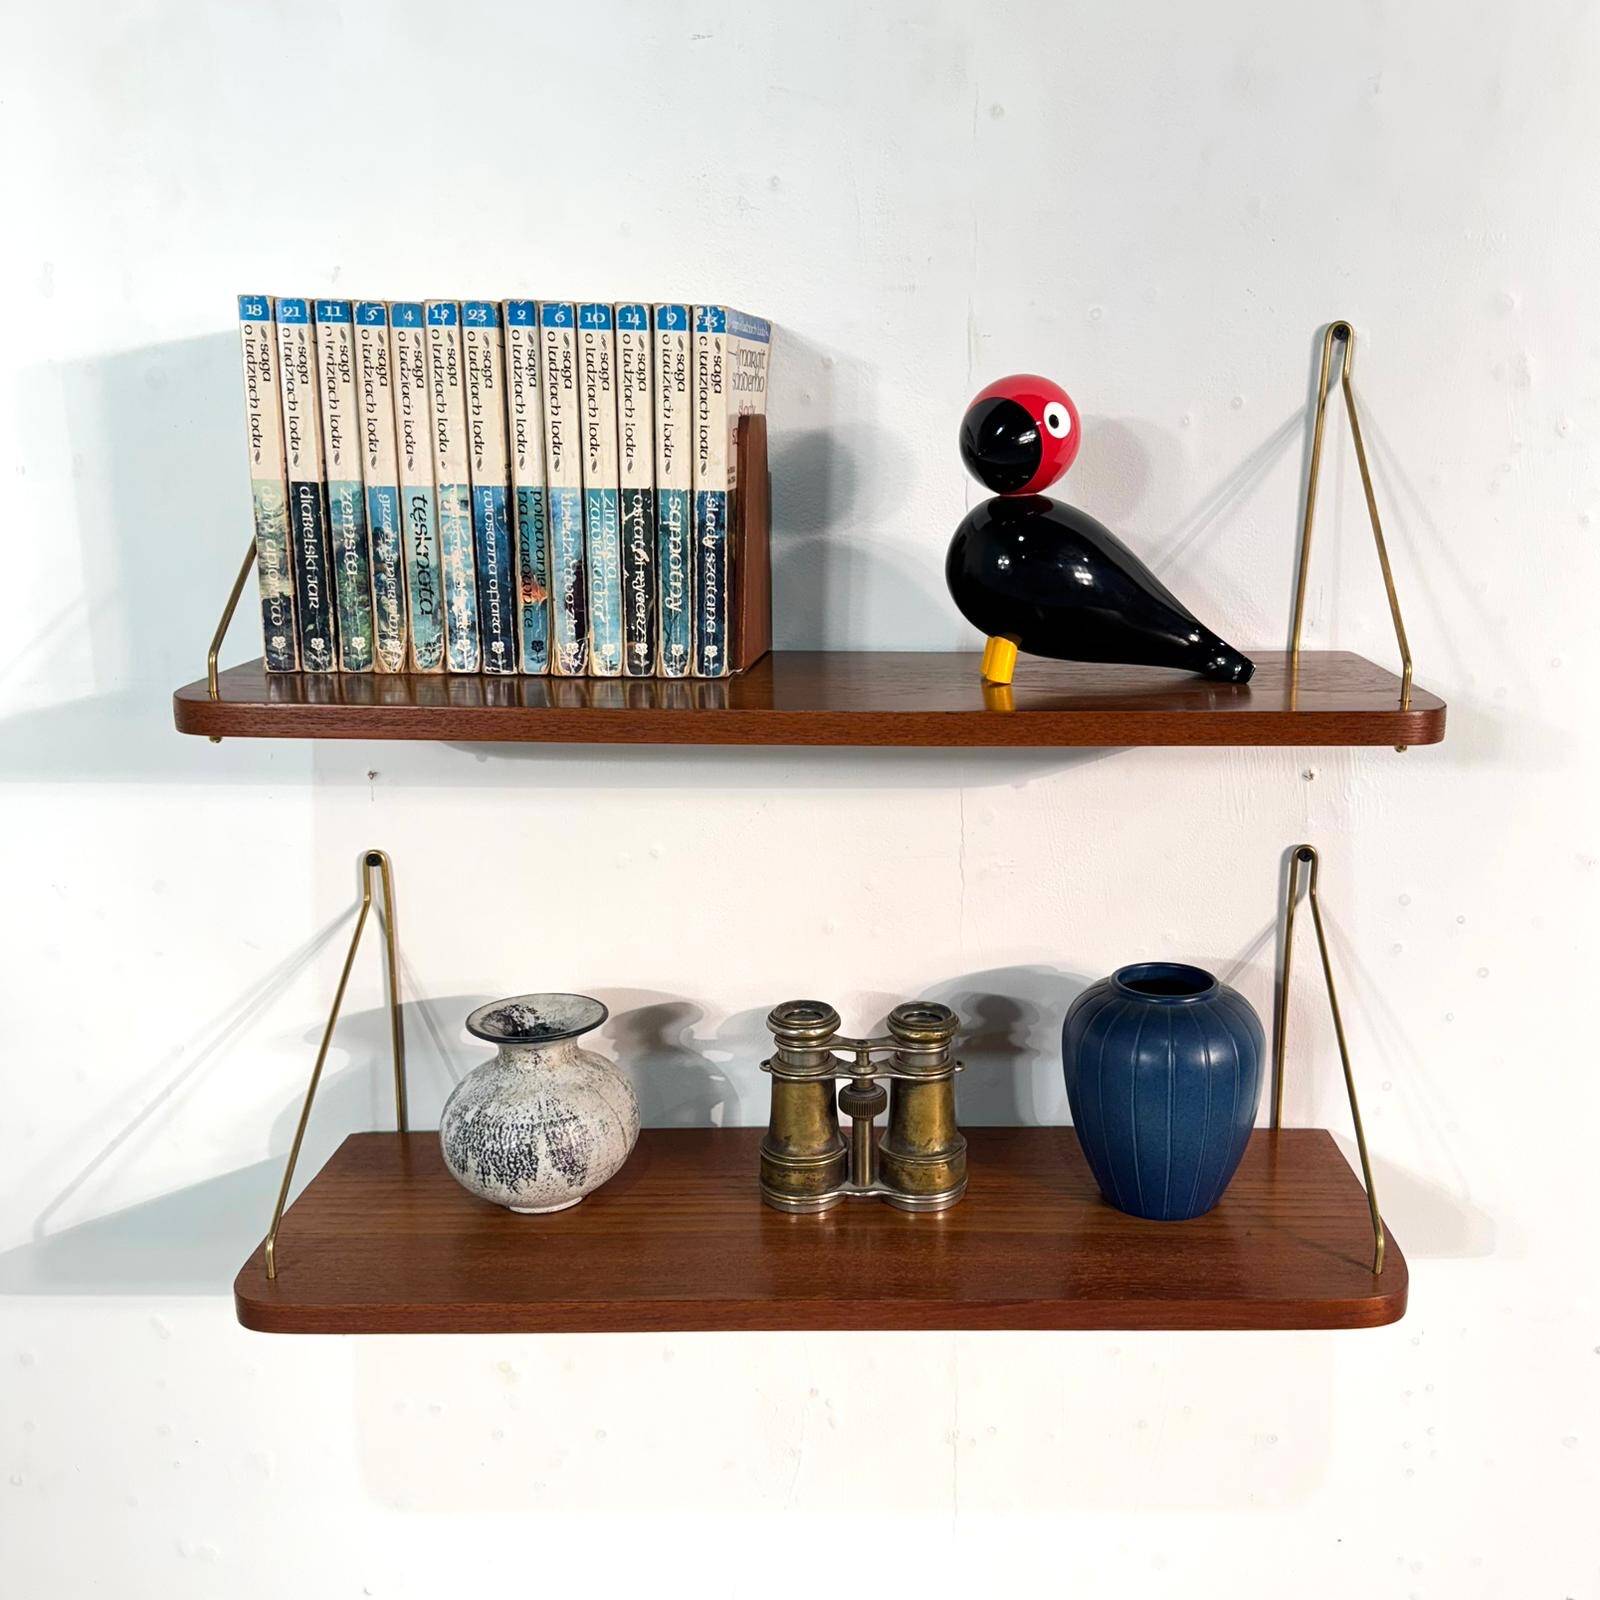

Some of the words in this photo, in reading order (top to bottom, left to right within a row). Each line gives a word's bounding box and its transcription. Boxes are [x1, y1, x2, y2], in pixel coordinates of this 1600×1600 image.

[246, 305, 262, 316] 18
[284, 308, 300, 317] 21
[325, 306, 342, 316] 11
[366, 311, 378, 320] 5
[404, 311, 413, 321] 4
[468, 310, 486, 321] 23
[517, 311, 526, 319] 2
[555, 311, 564, 322] 6
[585, 313, 606, 322] 10
[625, 313, 640, 324] 14
[667, 313, 676, 324] 9
[244, 325, 252, 334] o
[283, 328, 290, 338] o
[361, 330, 369, 339] o
[398, 332, 406, 341] o
[432, 329, 439, 339] o
[468, 331, 475, 341] o
[512, 330, 520, 340] o
[548, 331, 555, 342] o
[585, 333, 593, 343] o
[623, 334, 631, 344] o
[663, 335, 670, 344] o
[700, 336, 707, 346] o
[246, 340, 260, 409] ludziach
[259, 344, 271, 382] saga
[284, 343, 297, 411] ludziach
[297, 346, 308, 384] saga
[337, 346, 350, 383] saga
[362, 345, 374, 414] ludziach
[375, 348, 388, 387] saga
[399, 346, 411, 416] ludziach
[412, 351, 424, 388] saga
[432, 344, 447, 414] ludziach
[445, 349, 457, 386] saga
[468, 346, 480, 415] ludziach
[482, 350, 493, 388] saga
[513, 344, 526, 415] ludziach
[526, 350, 536, 387] saga
[548, 346, 560, 416] ludziach
[561, 351, 572, 389] saga
[599, 353, 609, 391] saga
[636, 354, 646, 391] saga
[675, 354, 685, 392] saga
[712, 356, 722, 394] saga
[739, 350, 766, 376] margit
[586, 348, 597, 418] ludziach
[623, 349, 634, 418] ludziach
[663, 348, 673, 420] ludziach
[700, 351, 710, 420] ludziach
[251, 414, 263, 449] lodu
[290, 416, 300, 452] lodu
[330, 415, 340, 449] lodu
[367, 418, 380, 453] lodu
[404, 420, 416, 455] lodu
[437, 418, 448, 453] lodu
[472, 419, 483, 455] lodu
[517, 419, 527, 453] lodu
[552, 420, 563, 455] lodu
[589, 422, 600, 457] lodu
[624, 423, 635, 458] lodu
[663, 424, 673, 459] lodu
[700, 424, 710, 459] lodu
[519, 491, 528, 516] na
[340, 487, 357, 574] zemsta
[484, 490, 498, 575] wiosenna
[533, 491, 545, 587] polowanie
[605, 497, 616, 579] zimowa
[703, 497, 717, 548] ślady
[411, 495, 432, 616] tęsknota
[590, 497, 604, 617] zawierucha
[666, 497, 682, 612] samotny
[519, 521, 534, 628] czarownice
[705, 552, 717, 632] szatana
[486, 579, 500, 634] ofiara
